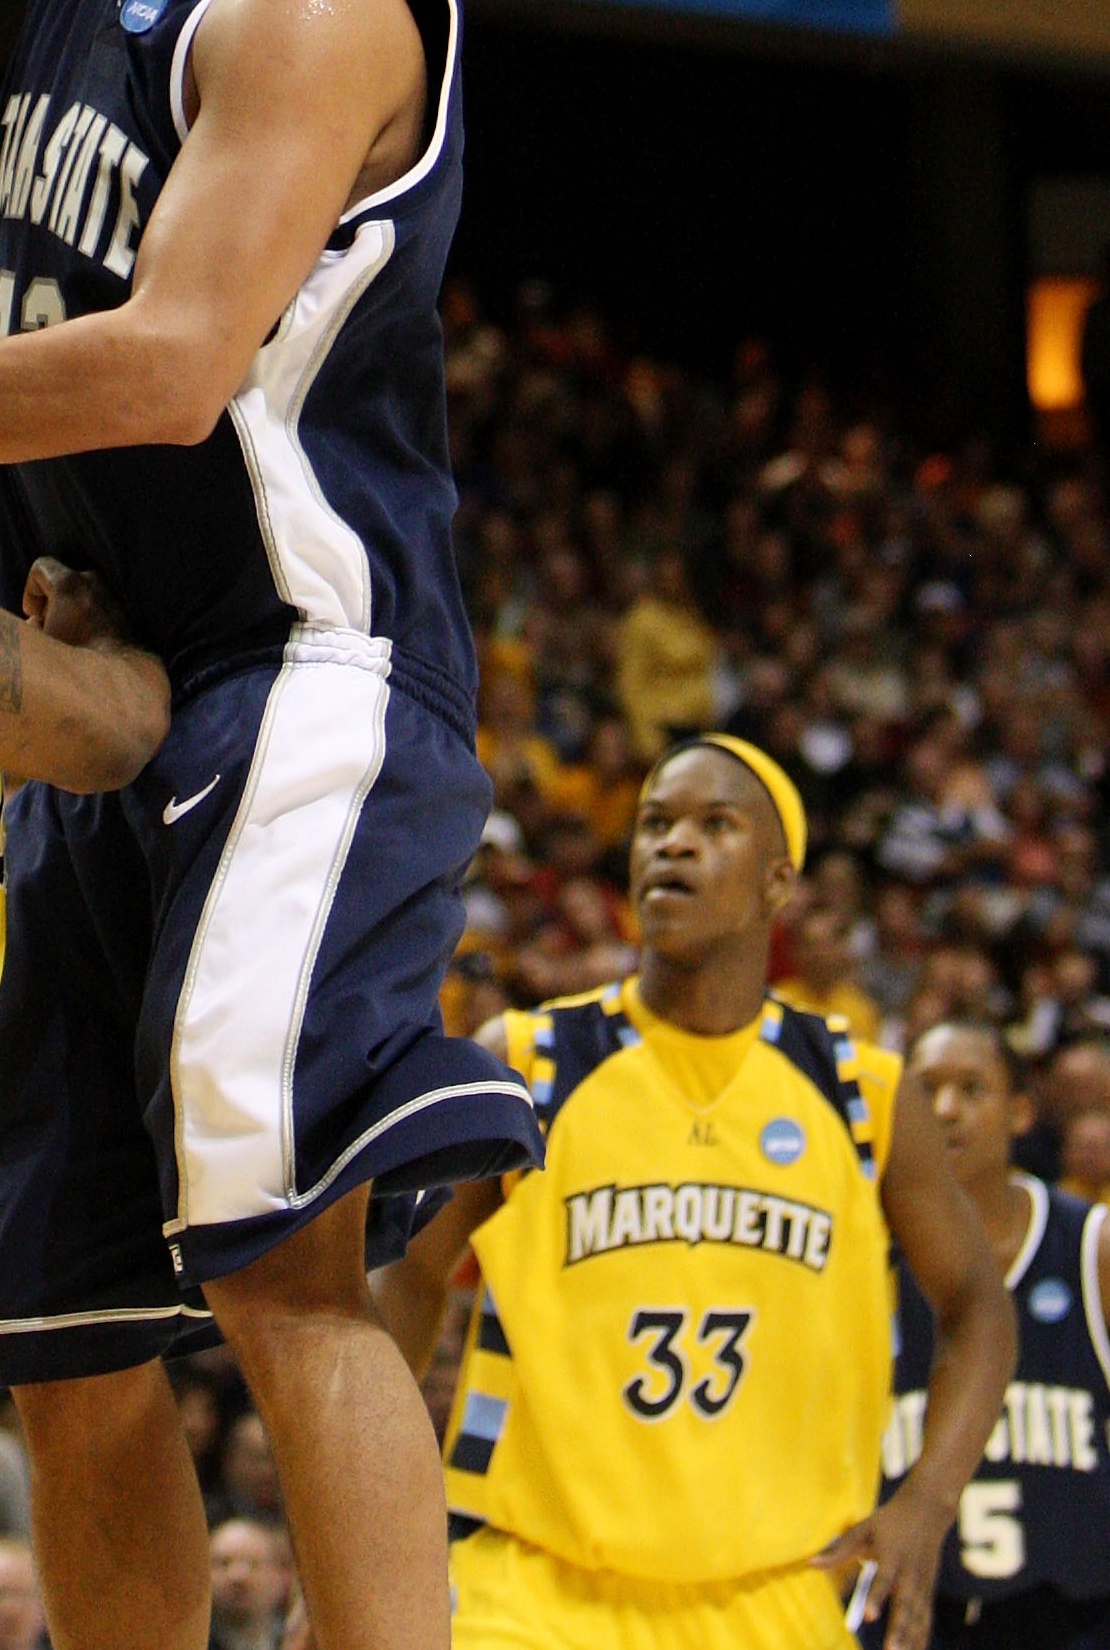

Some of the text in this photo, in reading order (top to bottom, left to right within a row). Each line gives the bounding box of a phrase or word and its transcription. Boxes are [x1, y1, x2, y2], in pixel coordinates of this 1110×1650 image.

[29, 101, 150, 281] STATE
[563, 1181, 833, 1273] MARQUETTE
[623, 1305, 757, 1422] 33
[960, 1481, 1026, 1579] 5
